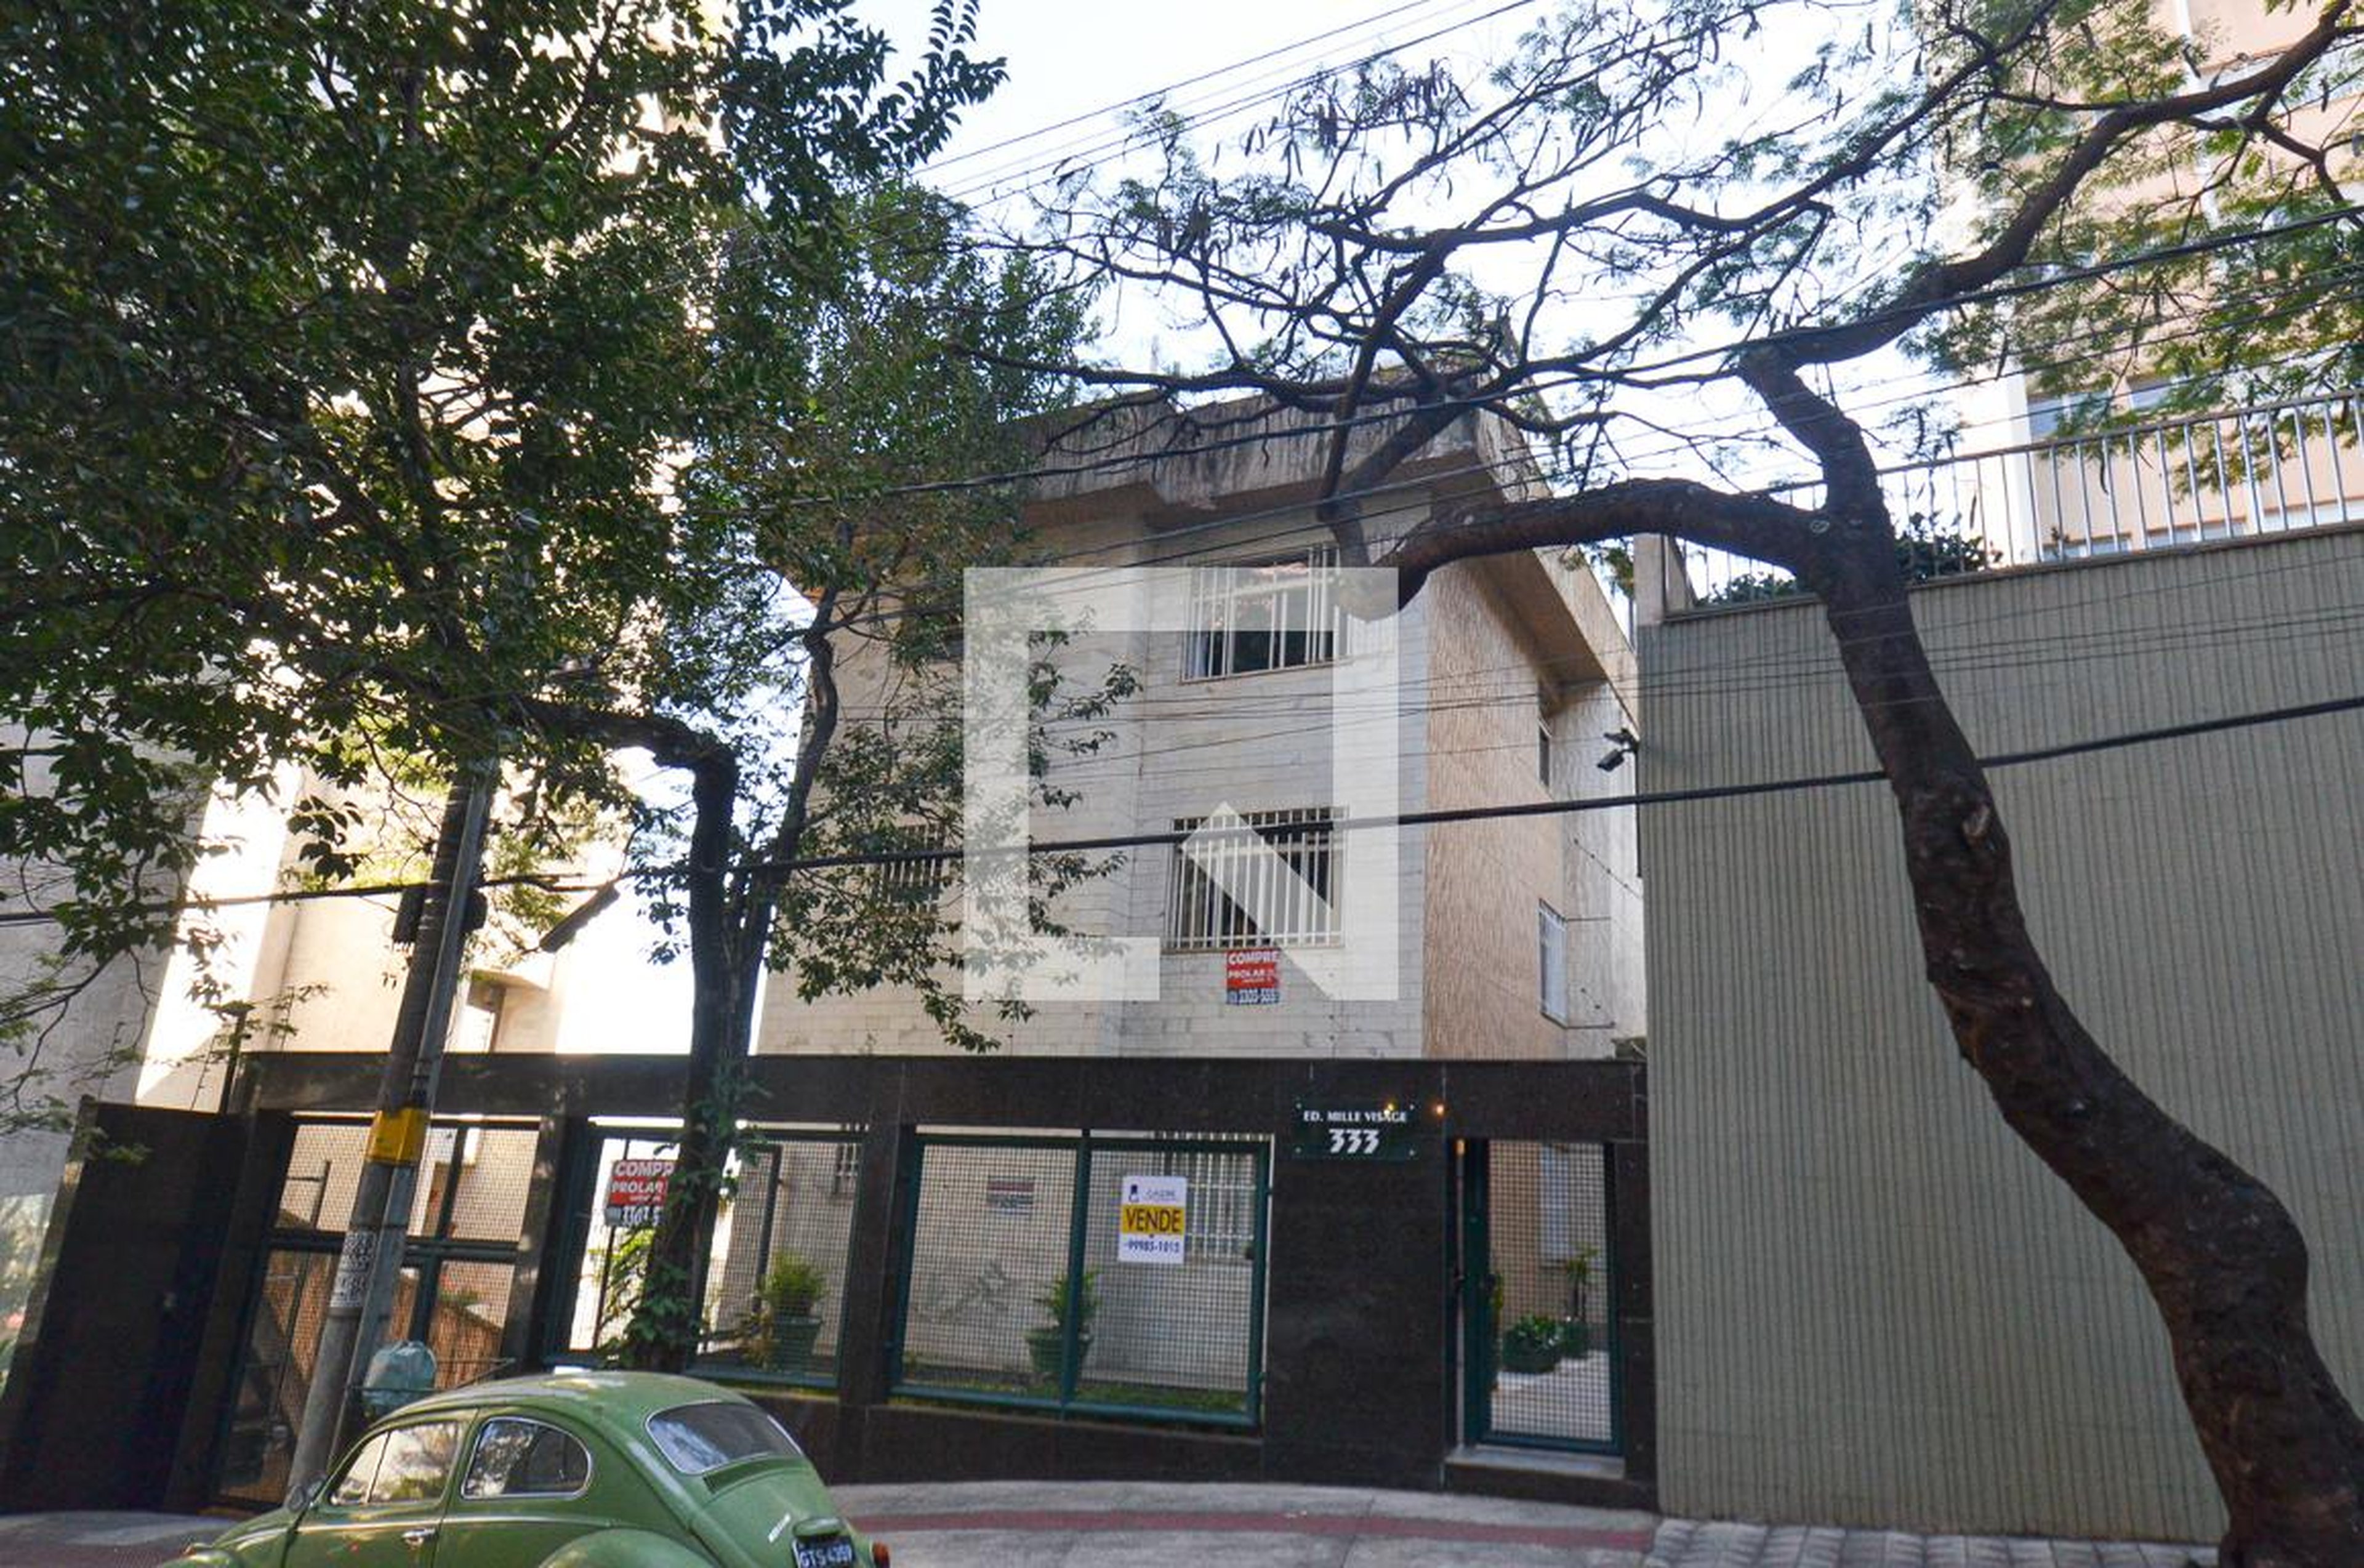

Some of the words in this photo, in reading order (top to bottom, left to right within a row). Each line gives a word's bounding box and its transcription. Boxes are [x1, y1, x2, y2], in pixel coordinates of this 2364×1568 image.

[1229, 951, 1278, 965] COMPRE
[1303, 1110, 1324, 1122] ED.
[1327, 1111, 1362, 1122] MILLE
[1364, 1111, 1408, 1123] VISAGE
[1329, 1128, 1380, 1154] 333
[1125, 1208, 1181, 1233] VENDE
